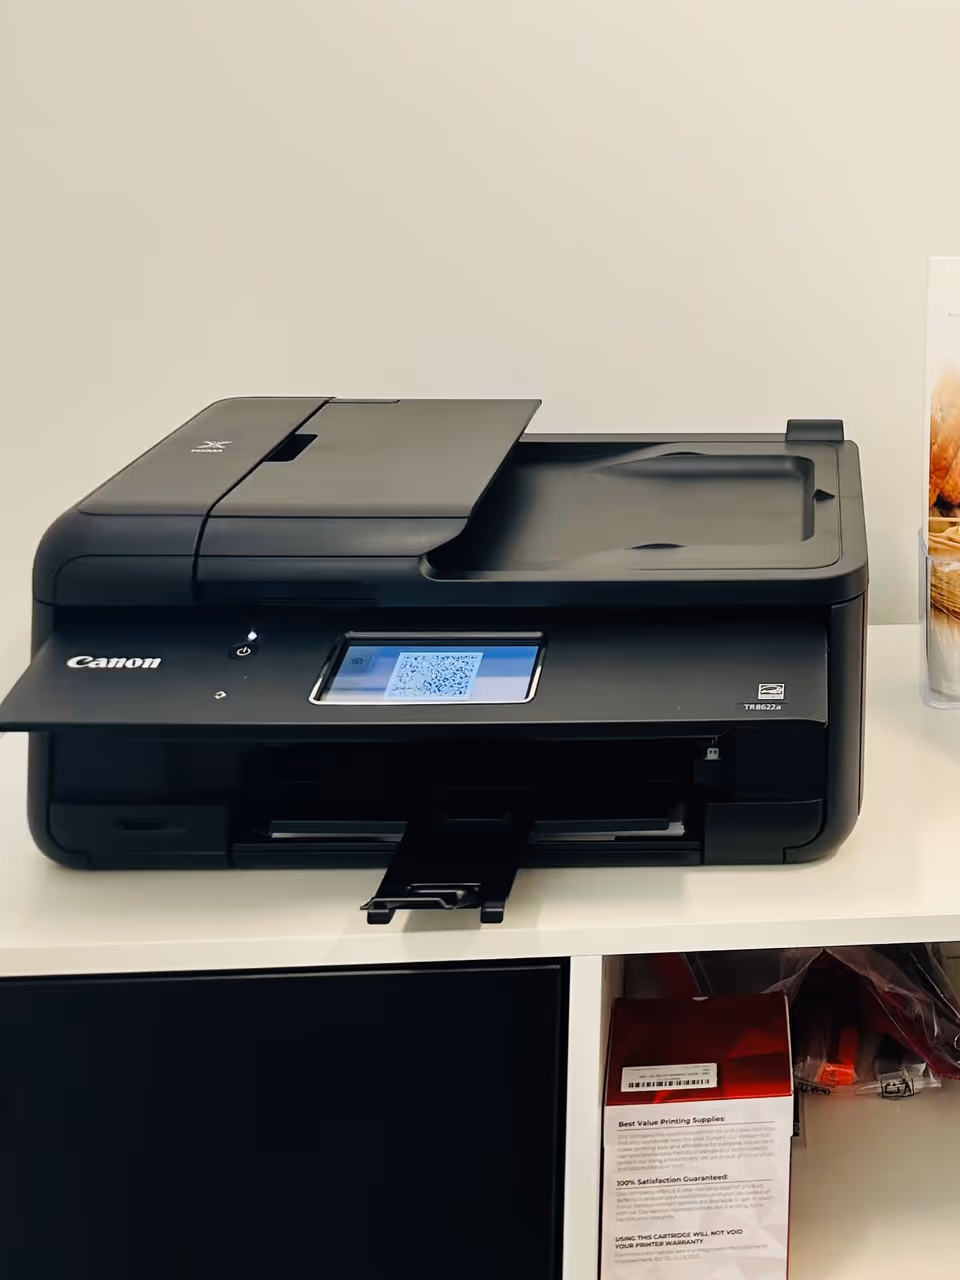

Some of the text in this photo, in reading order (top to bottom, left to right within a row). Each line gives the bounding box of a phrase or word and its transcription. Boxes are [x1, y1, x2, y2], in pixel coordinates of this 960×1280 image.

[66, 655, 162, 668] Canon
[743, 703, 782, 711] TR8622a
[693, 1115, 727, 1124] Supplies:
